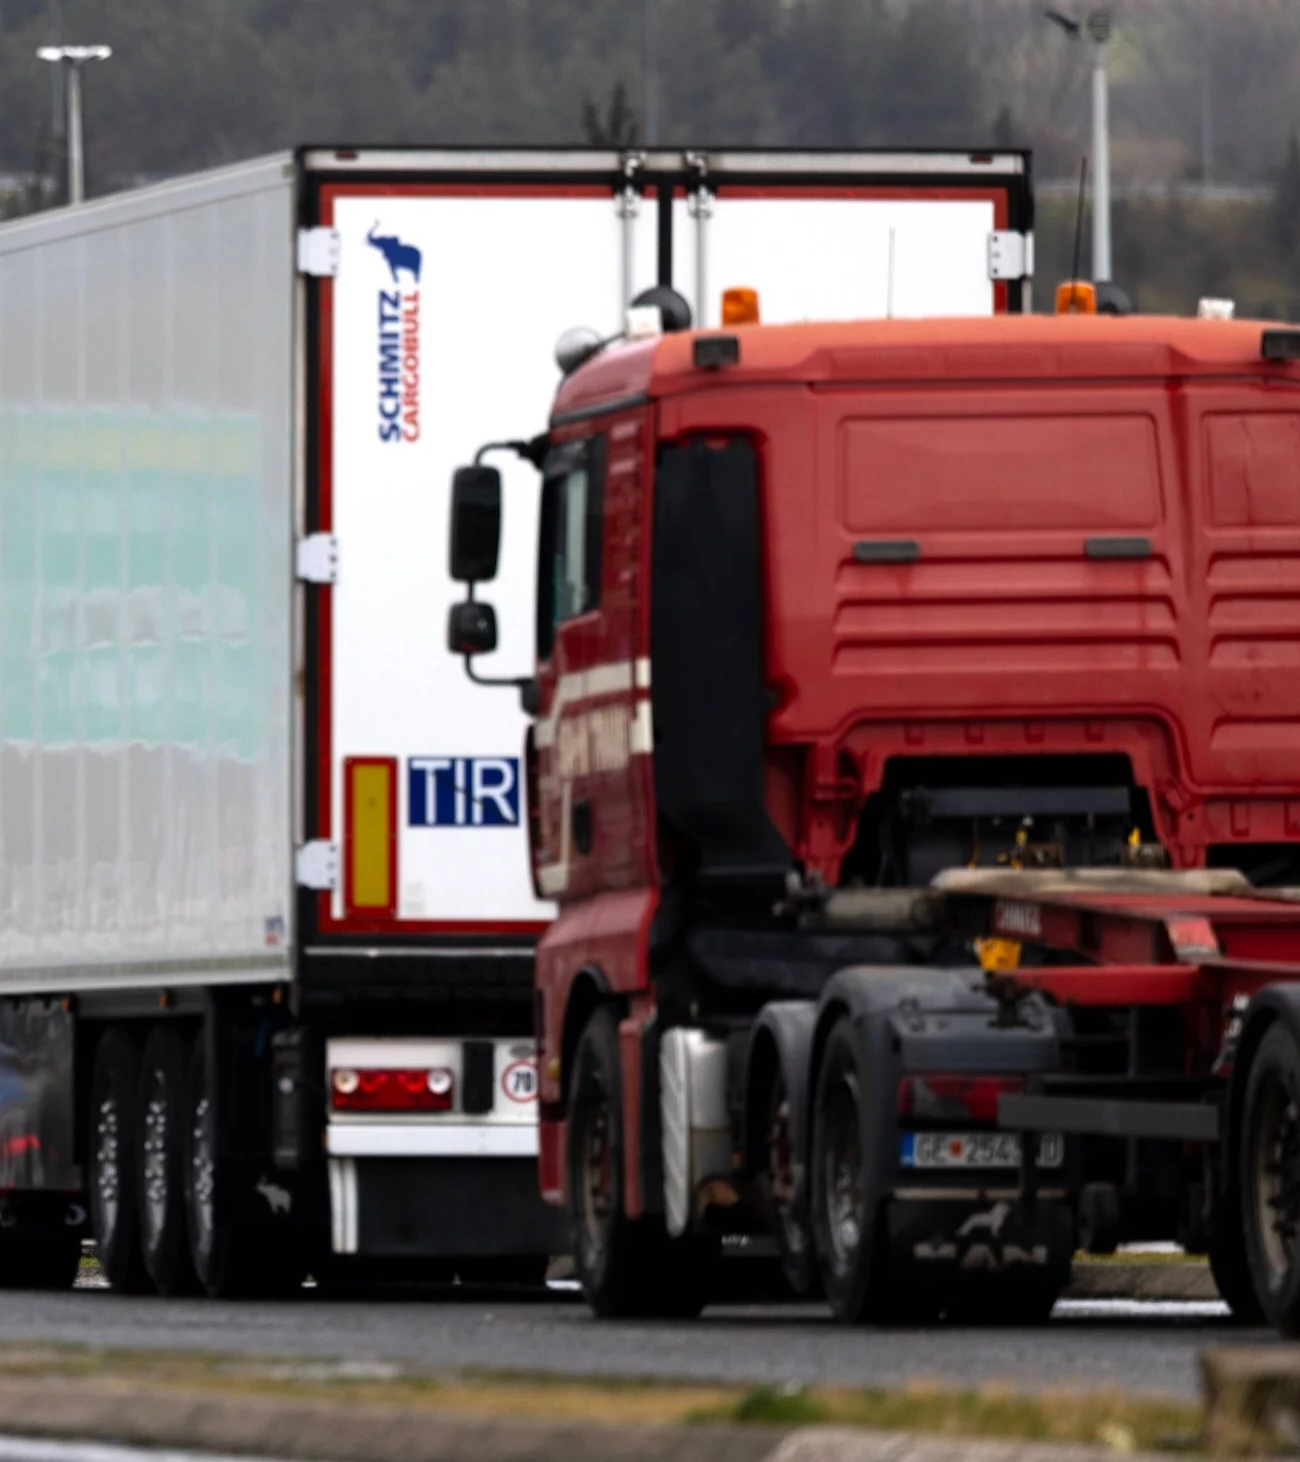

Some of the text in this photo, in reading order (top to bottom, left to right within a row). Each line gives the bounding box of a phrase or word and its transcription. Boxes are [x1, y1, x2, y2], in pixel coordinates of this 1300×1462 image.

[378, 290, 400, 442] SCHMITZ
[402, 290, 421, 443] CARGOBULL
[411, 759, 516, 825] TIR
